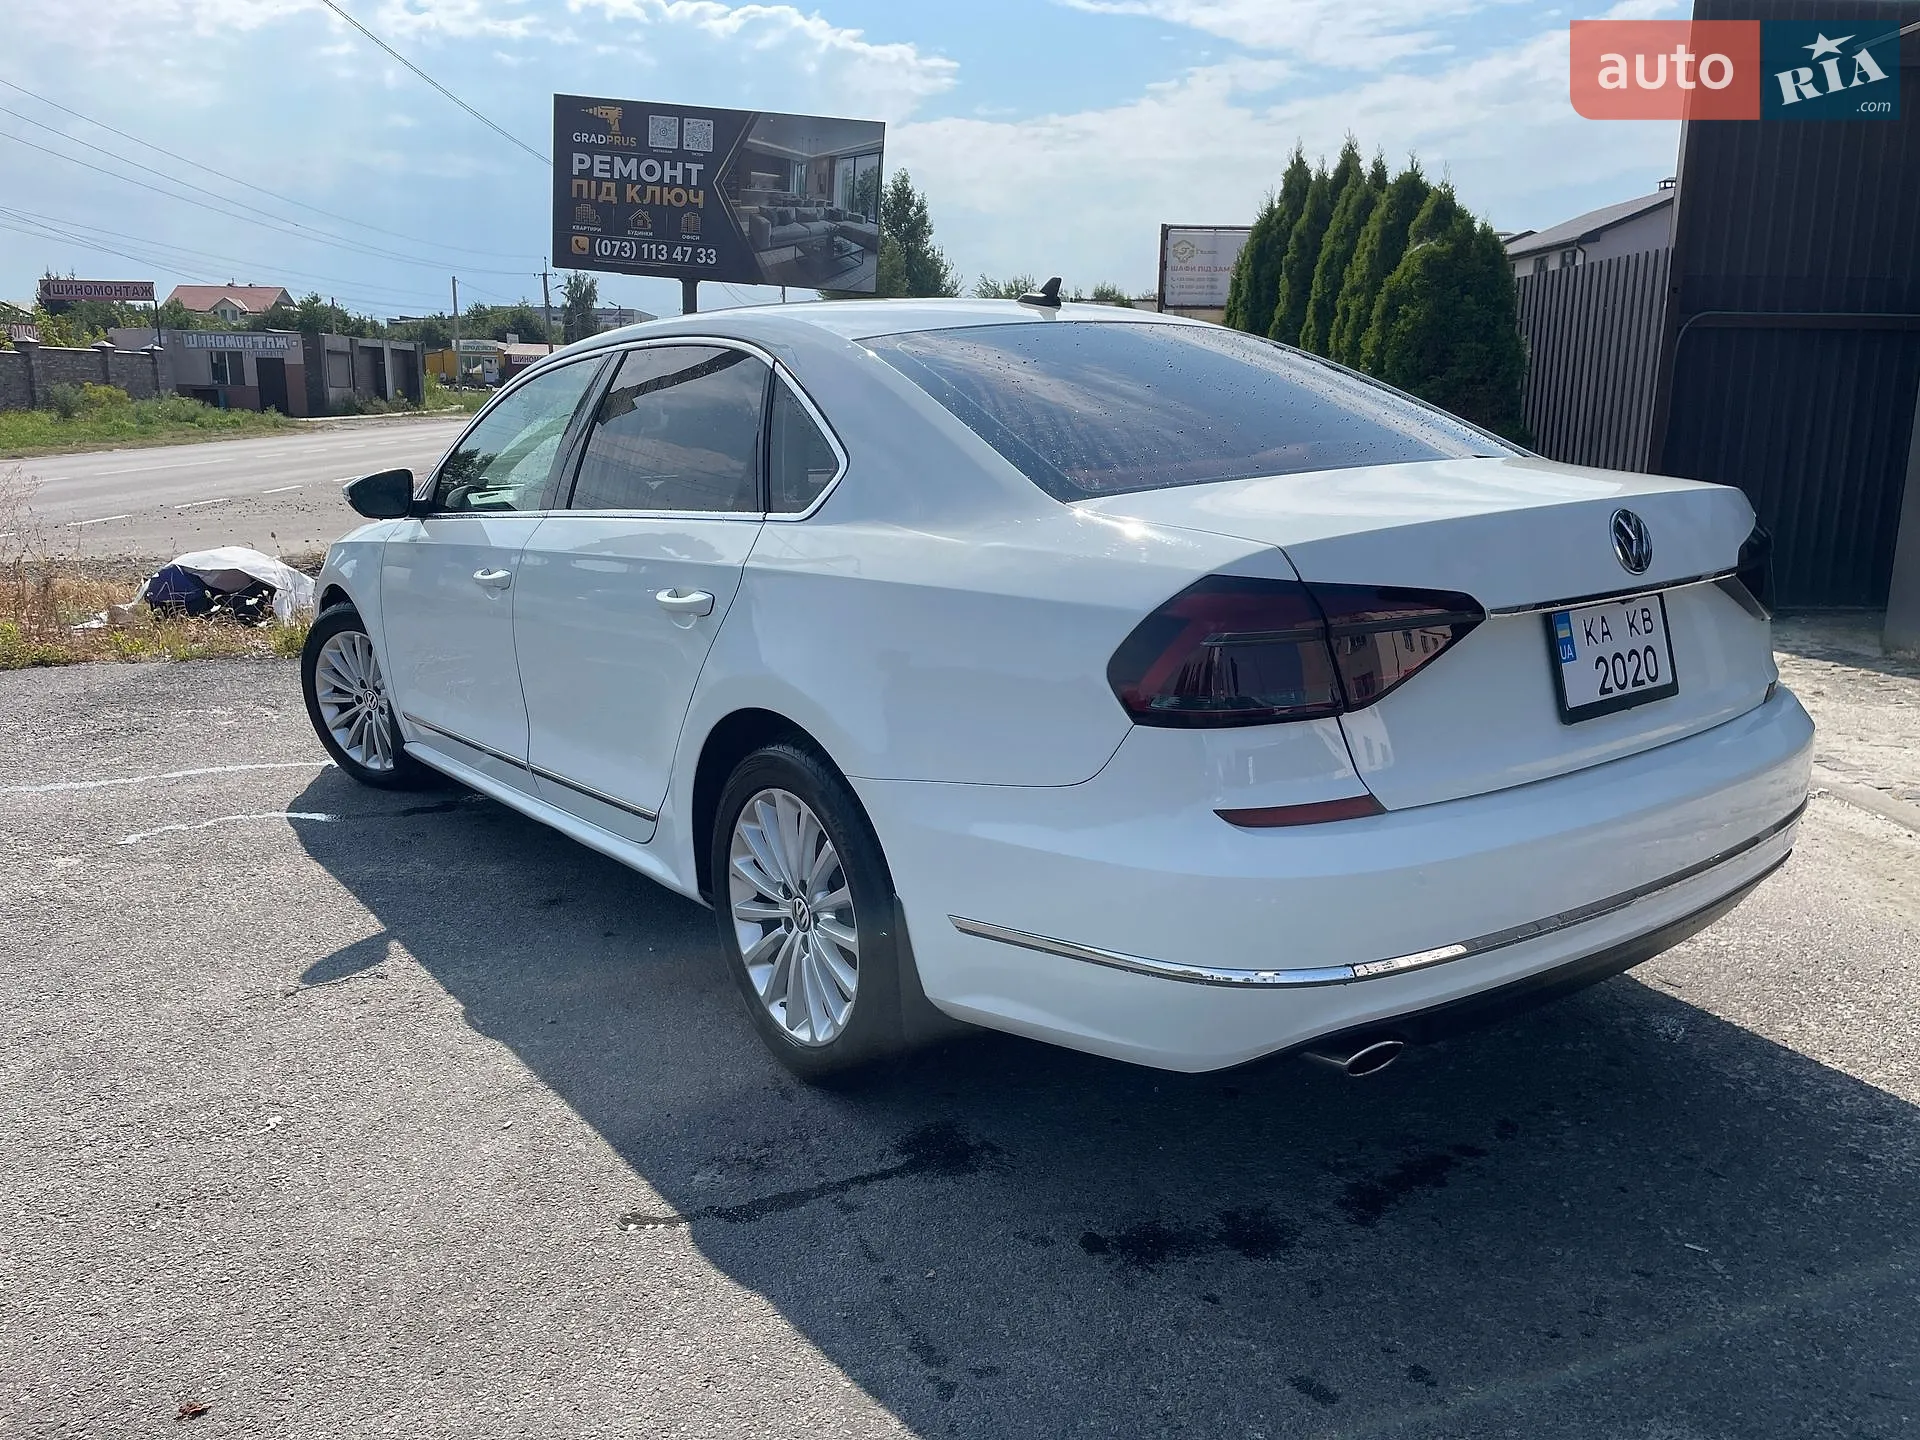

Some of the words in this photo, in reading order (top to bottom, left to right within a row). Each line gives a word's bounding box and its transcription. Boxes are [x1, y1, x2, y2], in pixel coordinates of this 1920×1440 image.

[572, 132, 637, 147] GRADPRUS
[572, 152, 704, 186] РЕМОНТ
[571, 179, 617, 205] ПІД
[626, 183, 704, 209] КЛЮЧ
[572, 225, 602, 233] КВАРТИРИ
[627, 229, 653, 237] БУДИНКИ
[595, 238, 637, 260] (073)
[641, 243, 668, 261] 113
[672, 245, 692, 262] 47
[696, 247, 717, 265] 33
[52, 283, 154, 297] ШИНОМОНТАЖ
[182, 333, 289, 350] ШИНОМОНТАЖ
[1583, 616, 1613, 646] KA
[1625, 608, 1653, 638] KB
[1560, 644, 1574, 660] UA
[1595, 645, 1659, 696] 2020
